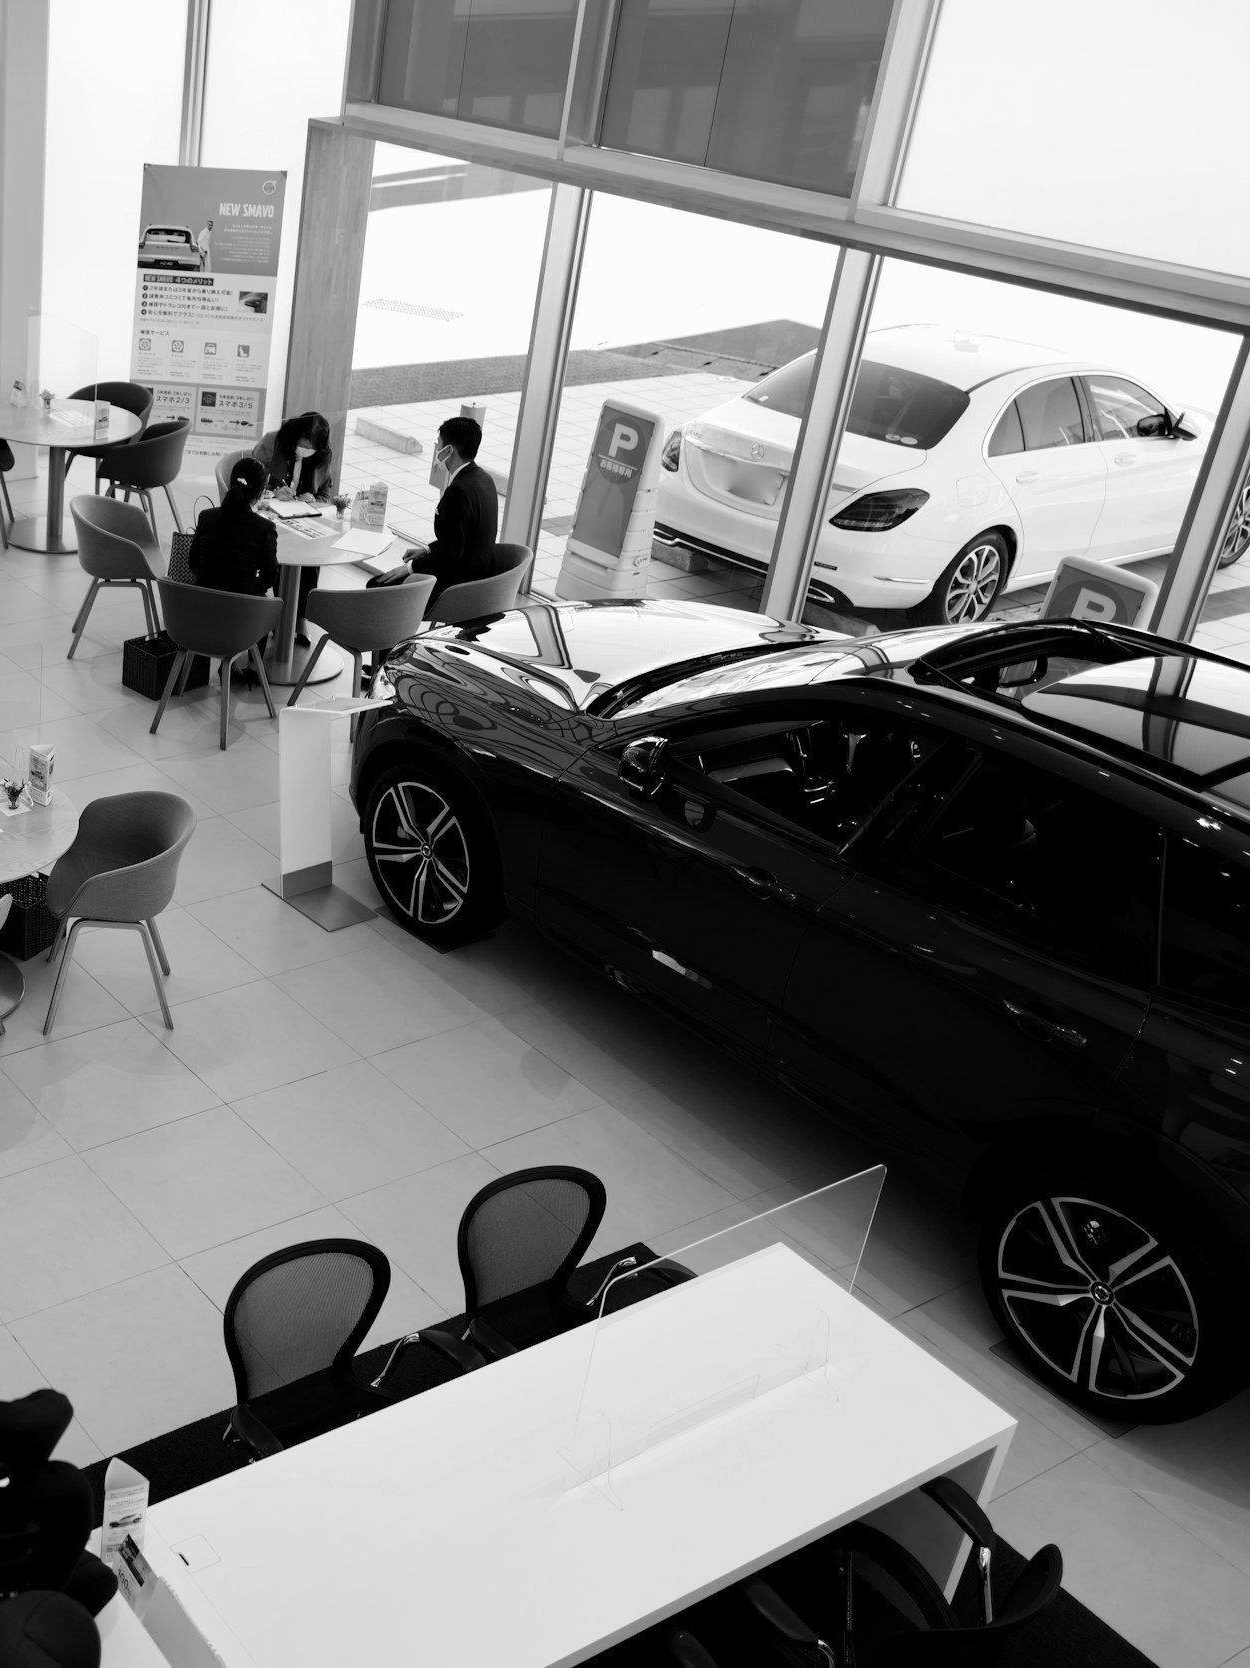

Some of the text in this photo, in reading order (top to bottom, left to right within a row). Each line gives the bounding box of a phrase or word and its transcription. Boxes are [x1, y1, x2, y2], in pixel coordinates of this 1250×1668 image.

[219, 202, 275, 218] NEW SMAVO
[175, 276, 213, 285] 4つのメリット
[608, 422, 639, 458] P
